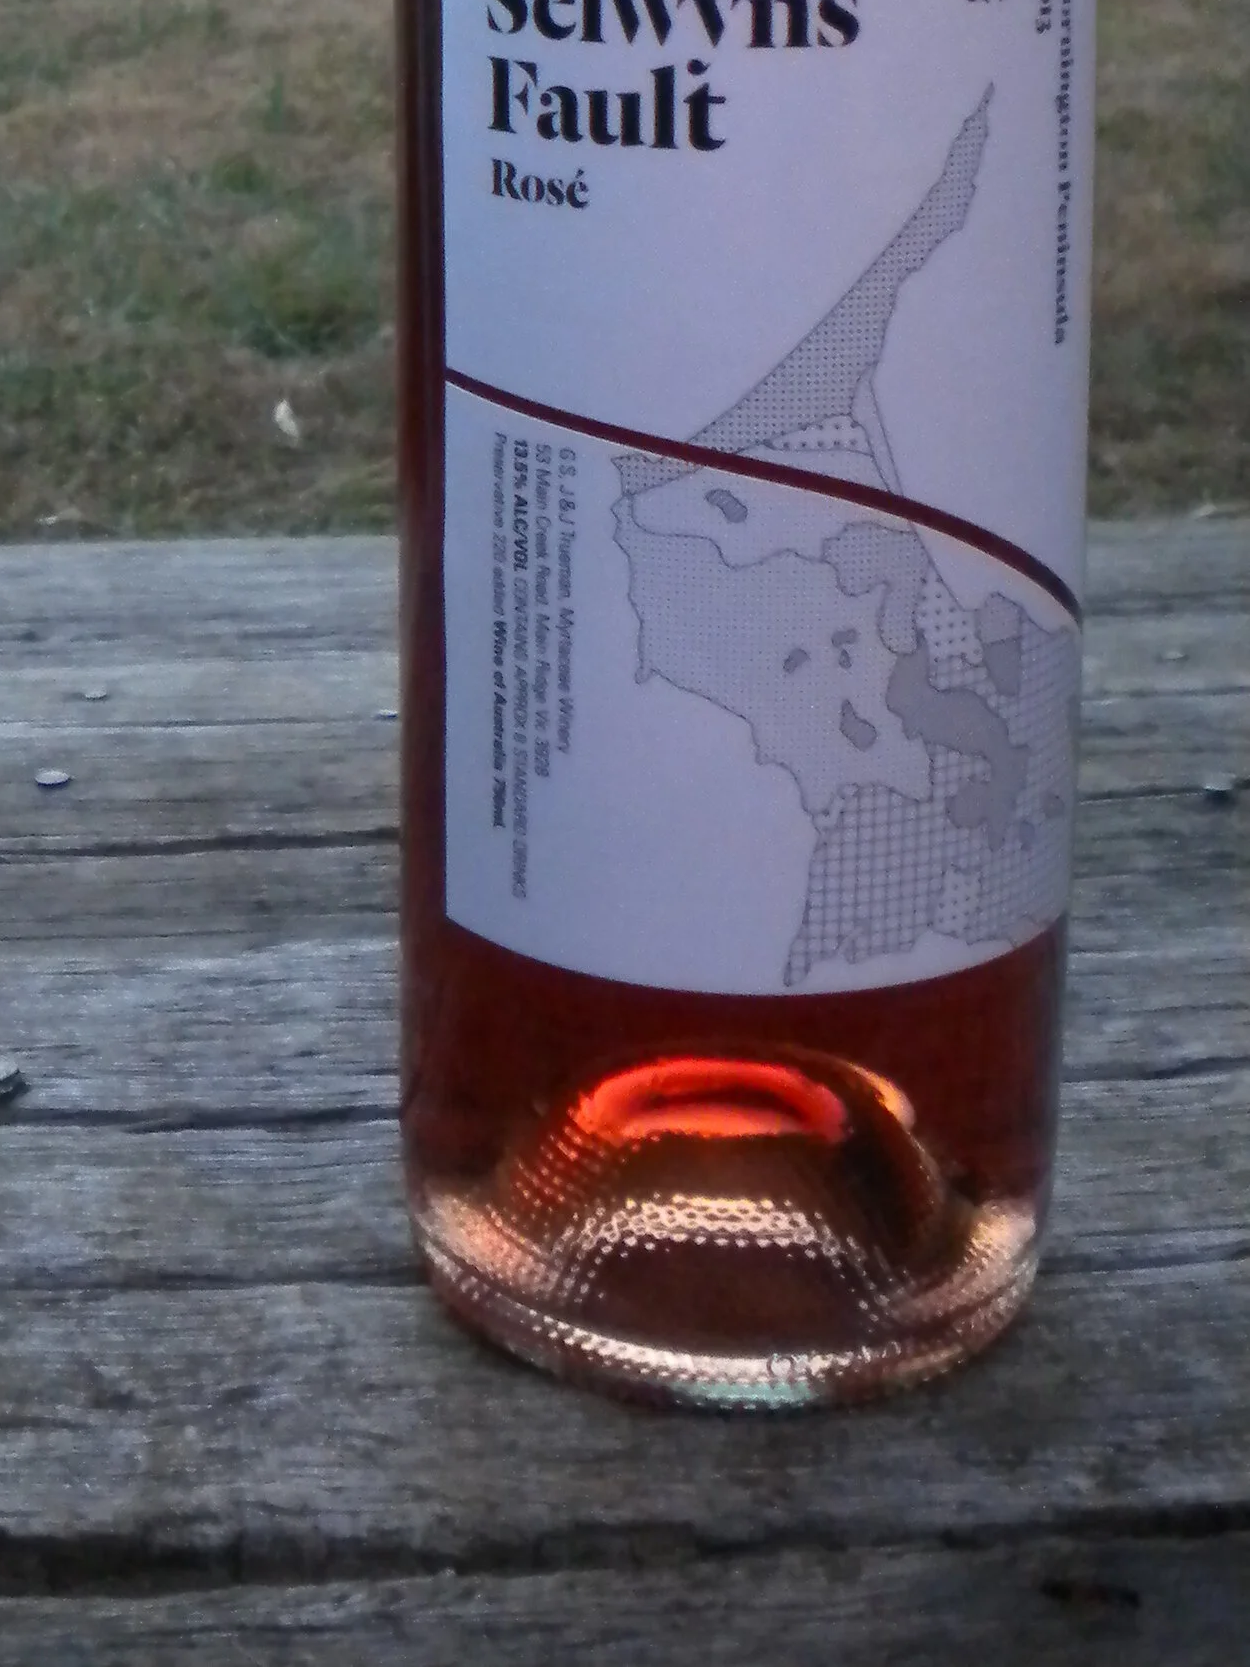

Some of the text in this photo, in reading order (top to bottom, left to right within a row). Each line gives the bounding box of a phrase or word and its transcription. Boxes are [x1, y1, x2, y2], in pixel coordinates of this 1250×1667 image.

[486, 55, 727, 152] Fault
[491, 157, 590, 209] Rosé
[493, 431, 507, 528] Preservative
[513, 439, 529, 490] 13.5%
[535, 443, 552, 465] 53
[535, 468, 552, 511] Main
[512, 494, 529, 571] ALC/VOL
[535, 516, 552, 559] Creek
[493, 565, 505, 615] added
[493, 620, 507, 666] Wine
[512, 577, 529, 661] CONTAINS
[493, 671, 506, 689] of
[532, 659, 551, 704] Ridge
[493, 692, 507, 771] Australia
[556, 697, 574, 754] Winery
[513, 747, 528, 836] STANDARD
[512, 839, 527, 898] DRINKS
